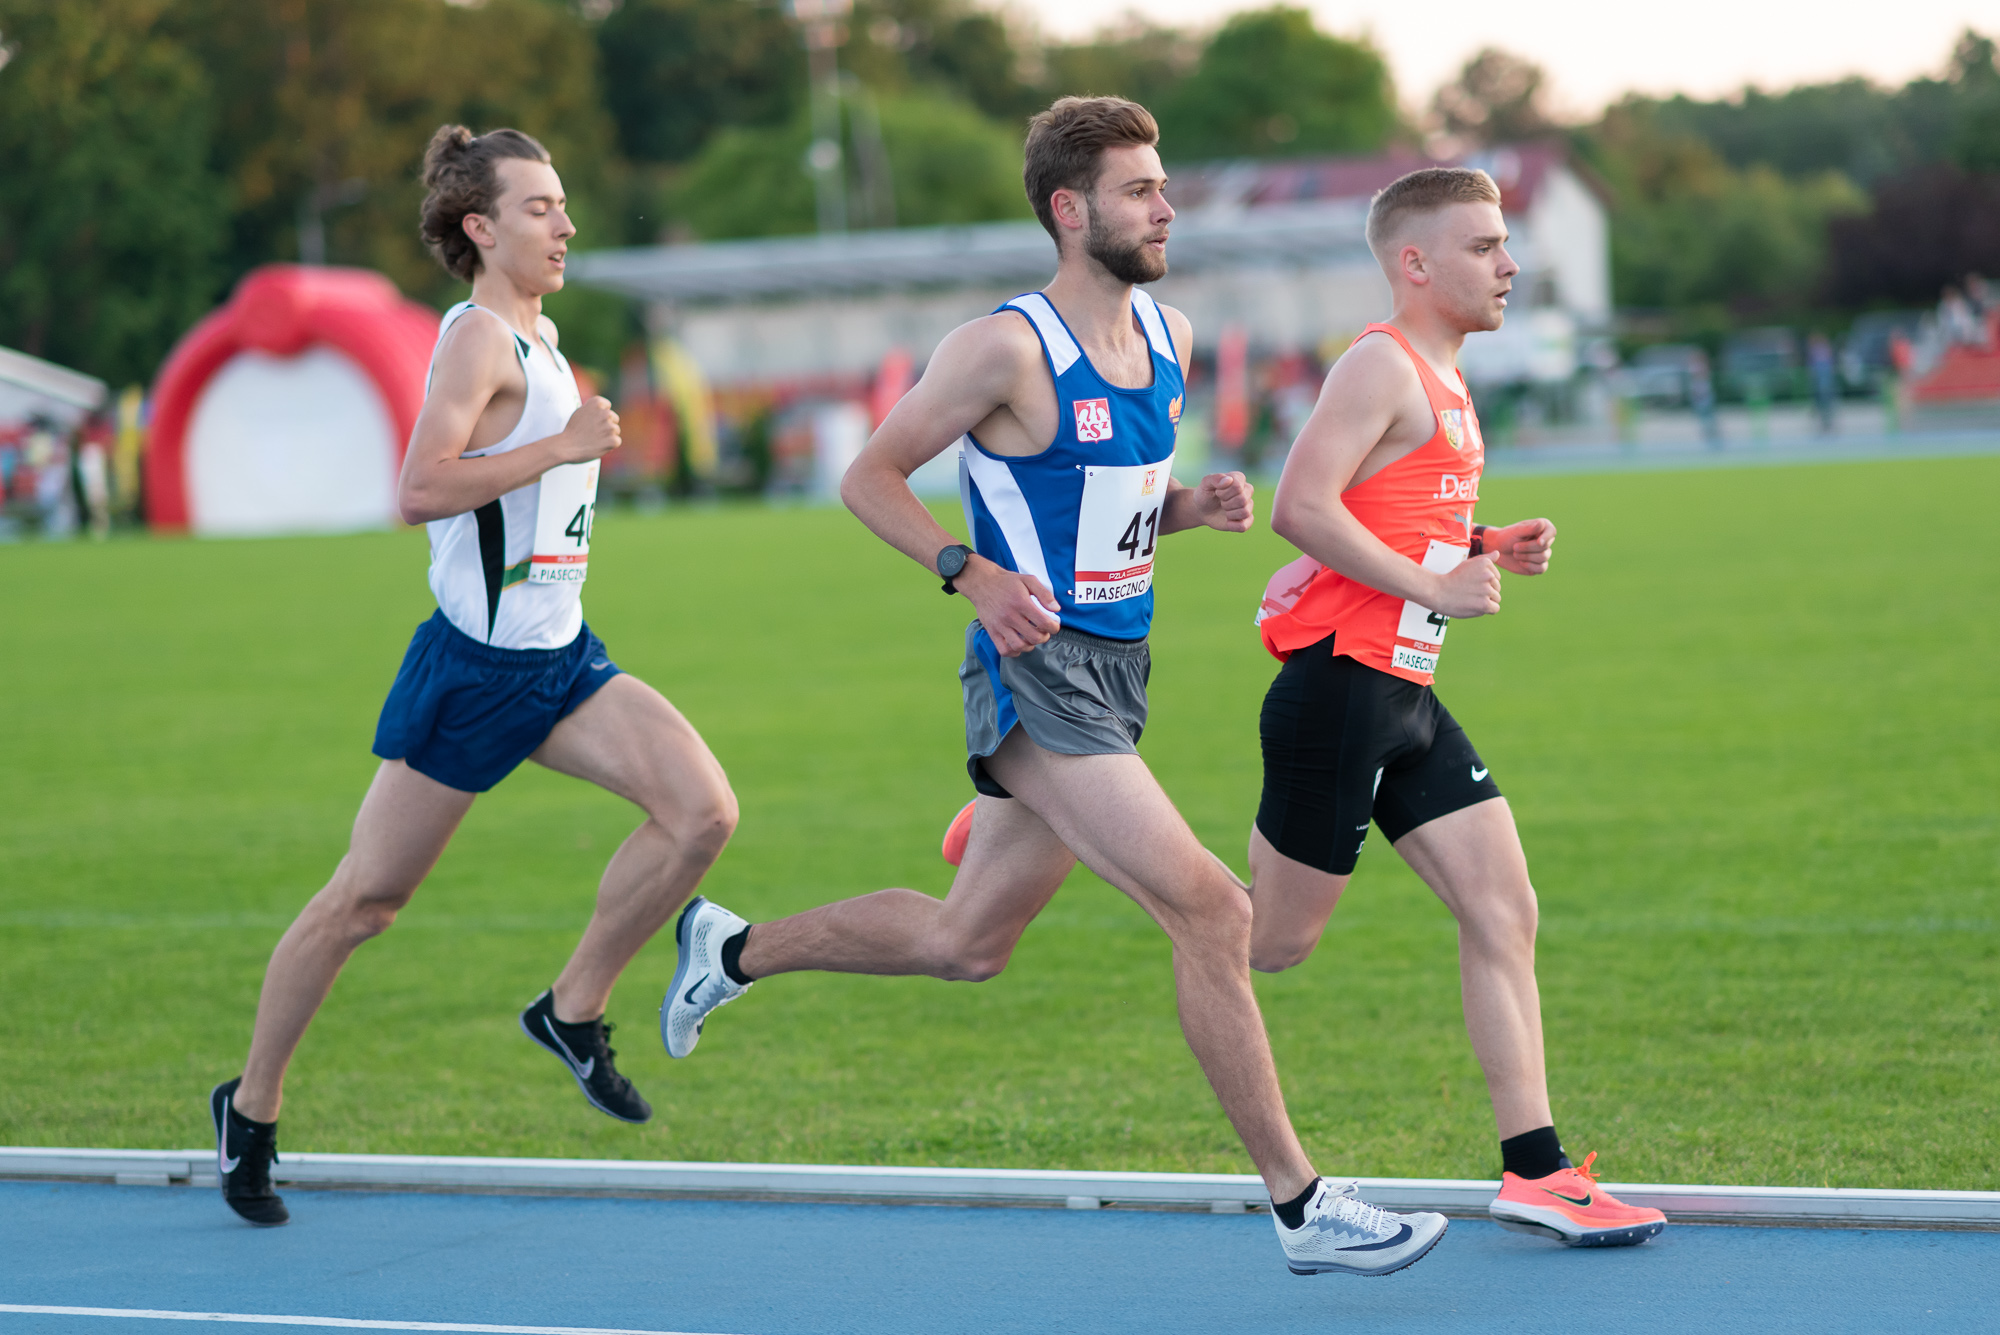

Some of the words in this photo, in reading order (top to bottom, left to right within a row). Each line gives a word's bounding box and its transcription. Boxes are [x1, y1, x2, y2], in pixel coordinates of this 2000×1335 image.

[1117, 506, 1159, 561] 41
[1108, 571, 1126, 580] PZLA
[1085, 579, 1145, 601] PIASECZNO
[1413, 640, 1430, 651] PZLA
